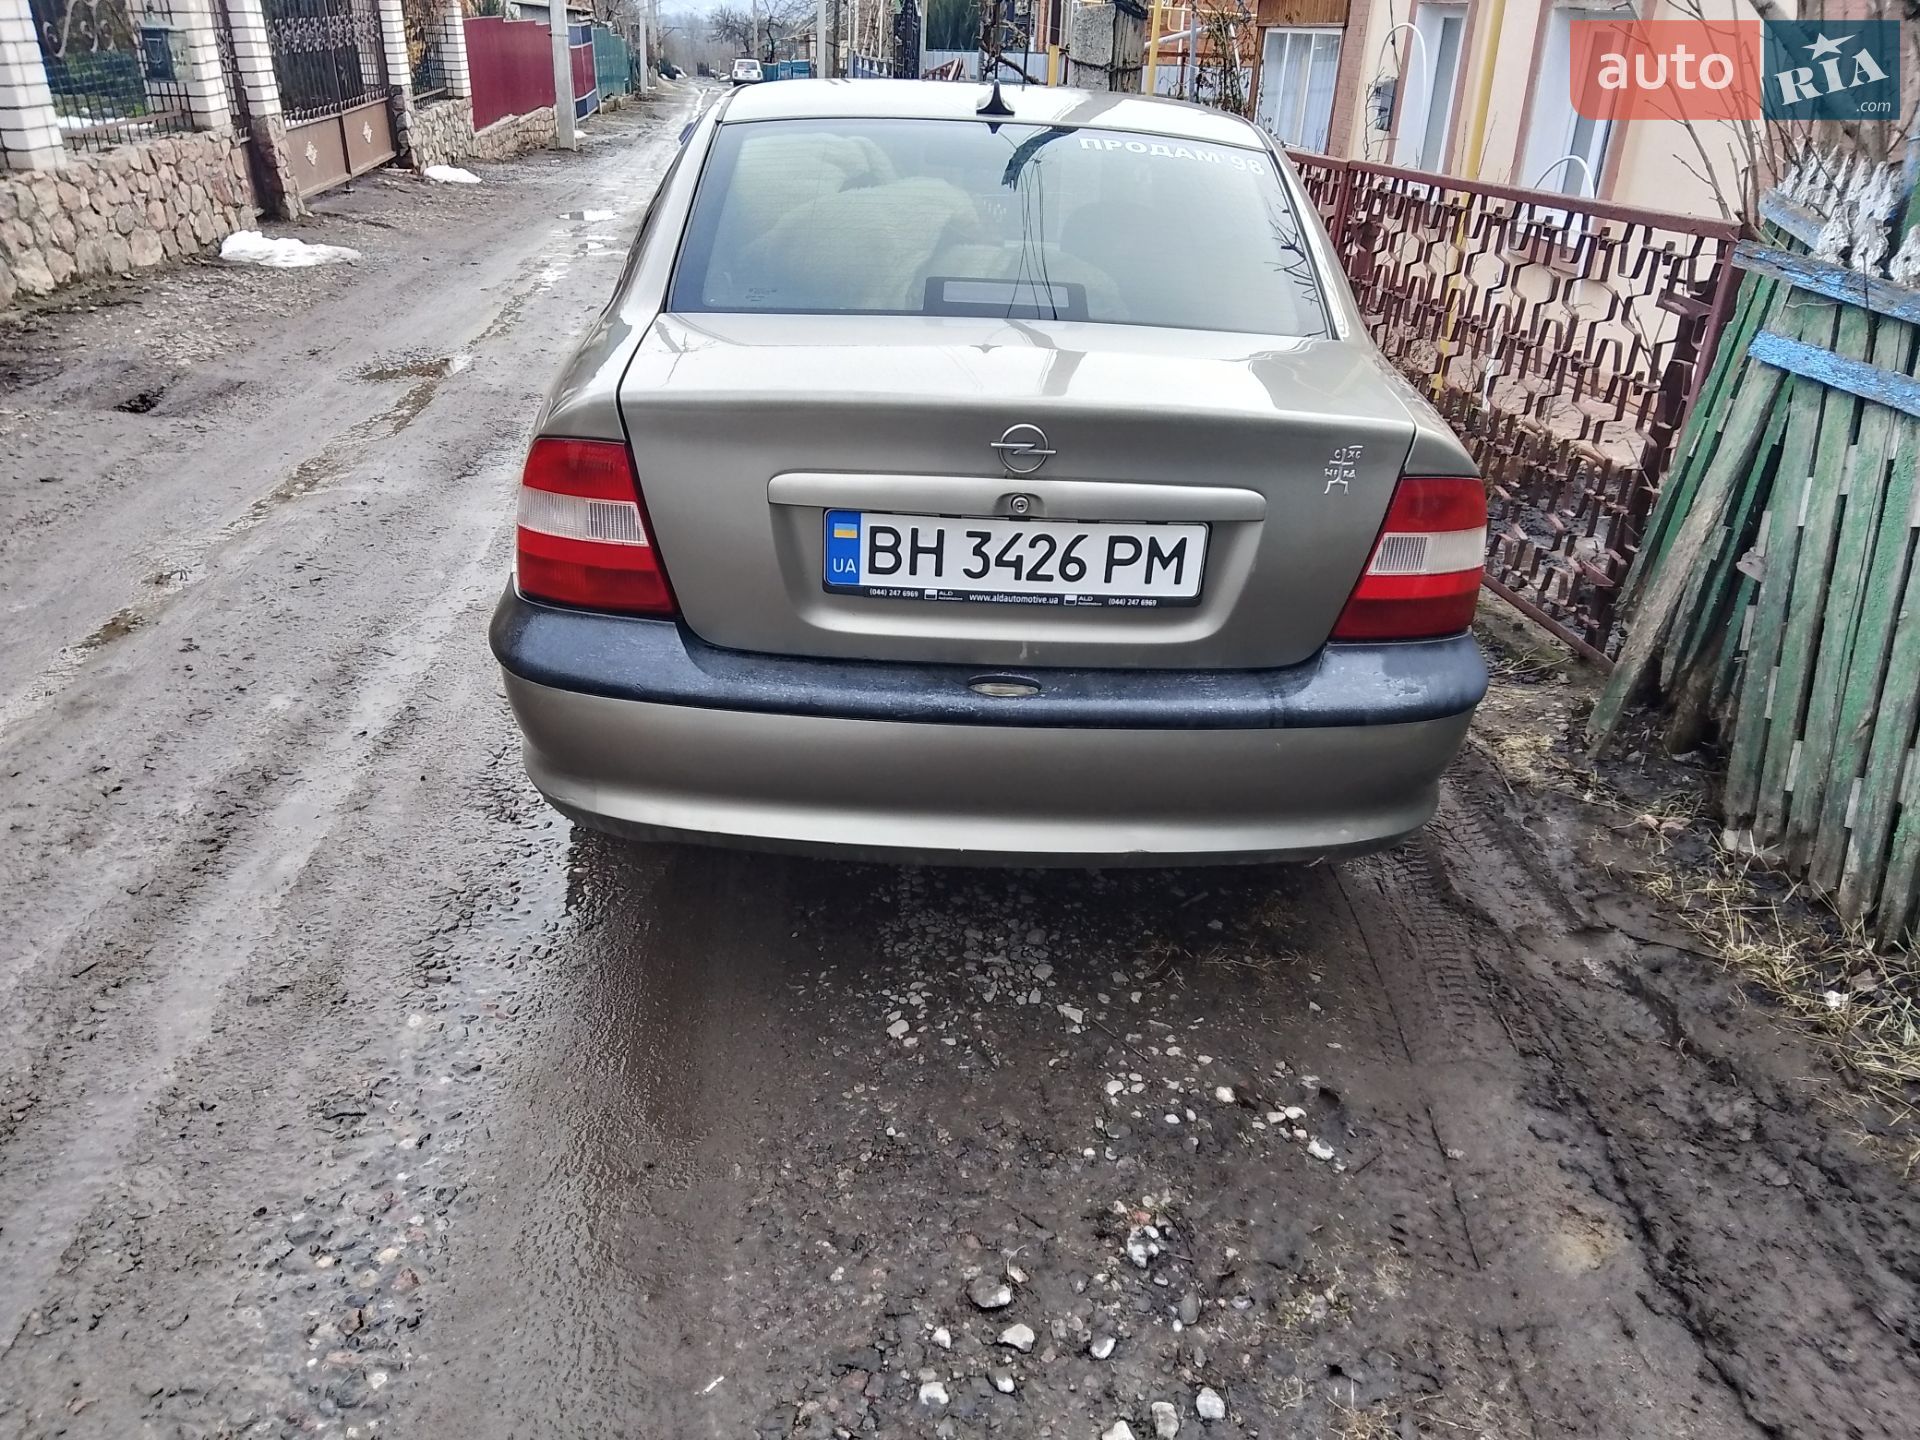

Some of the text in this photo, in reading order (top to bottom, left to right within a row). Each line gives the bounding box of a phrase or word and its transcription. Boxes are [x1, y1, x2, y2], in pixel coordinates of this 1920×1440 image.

[867, 525, 1188, 586] BH 3426 PM
[832, 558, 857, 575] UA
[869, 588, 919, 598] (044) 247 6969
[969, 593, 1059, 605] www.aldautomotive.ua
[1108, 597, 1126, 606] (044)
[1126, 598, 1139, 606] 247
